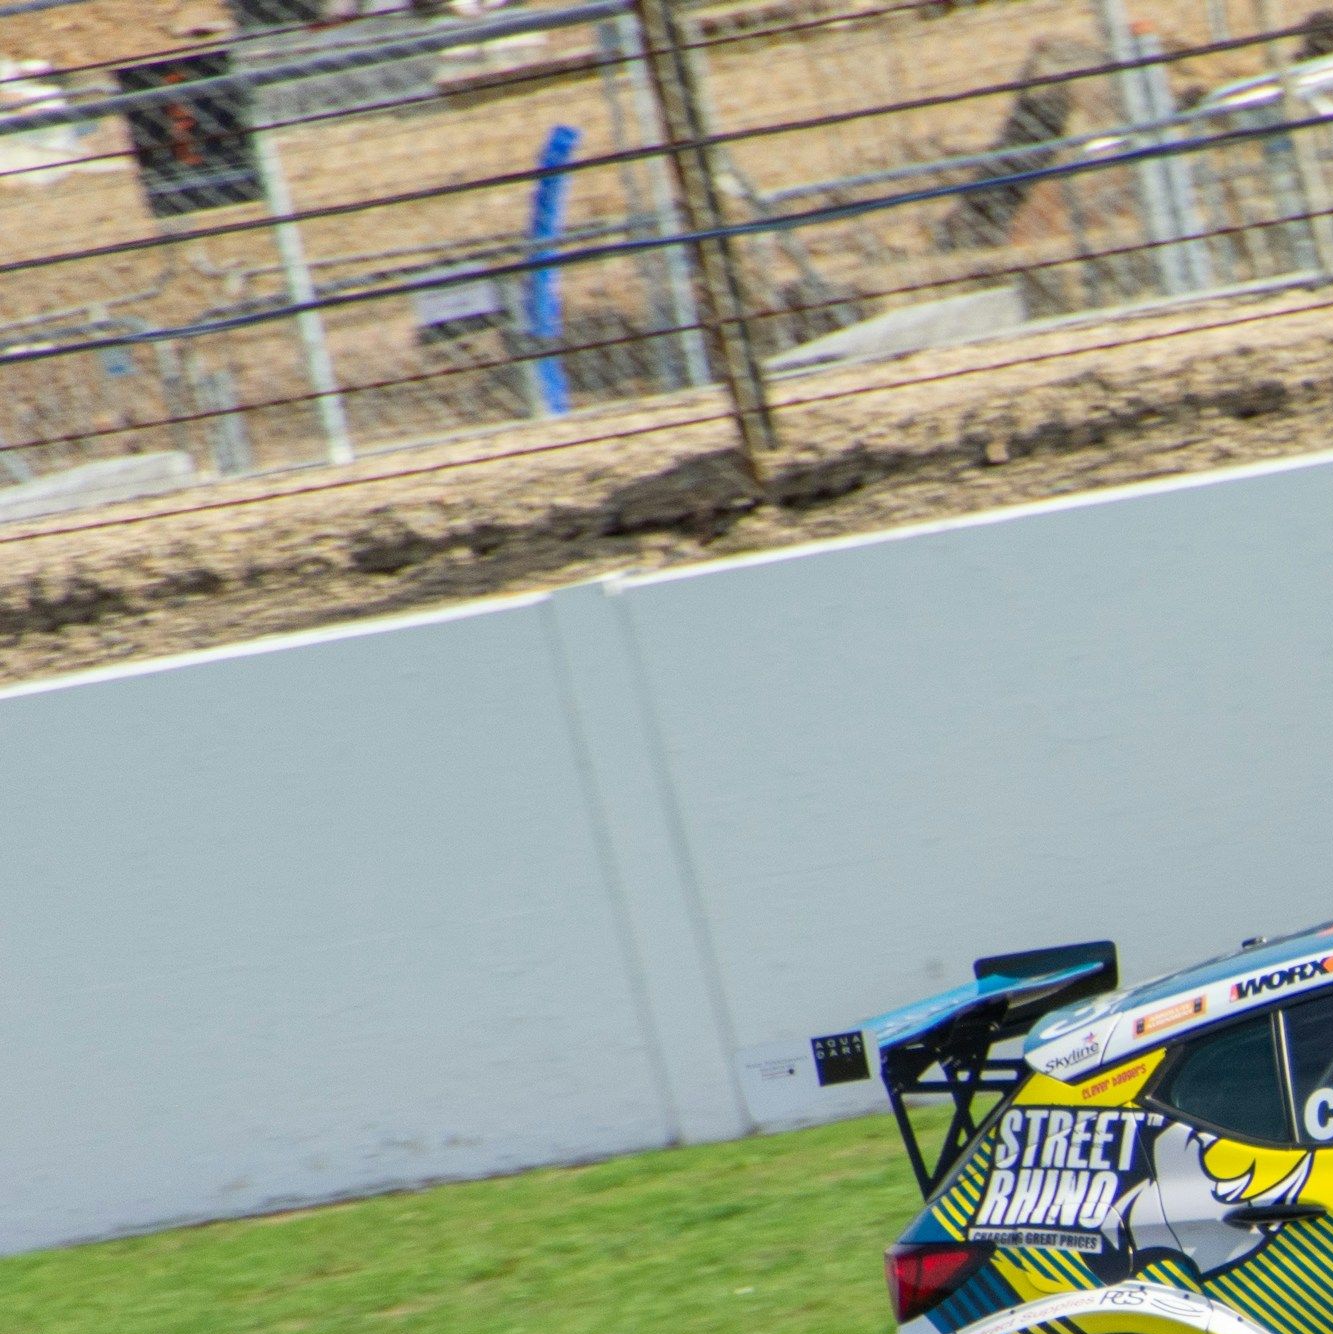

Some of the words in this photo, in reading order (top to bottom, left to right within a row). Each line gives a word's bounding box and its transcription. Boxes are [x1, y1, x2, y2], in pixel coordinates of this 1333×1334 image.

[1234, 958, 1330, 1000] WORX
[994, 1109, 1144, 1170] STREET
[975, 1169, 1119, 1228] RHINO
[1025, 1232, 1059, 1247] GREAT
[1060, 1235, 1098, 1250] PRICES
